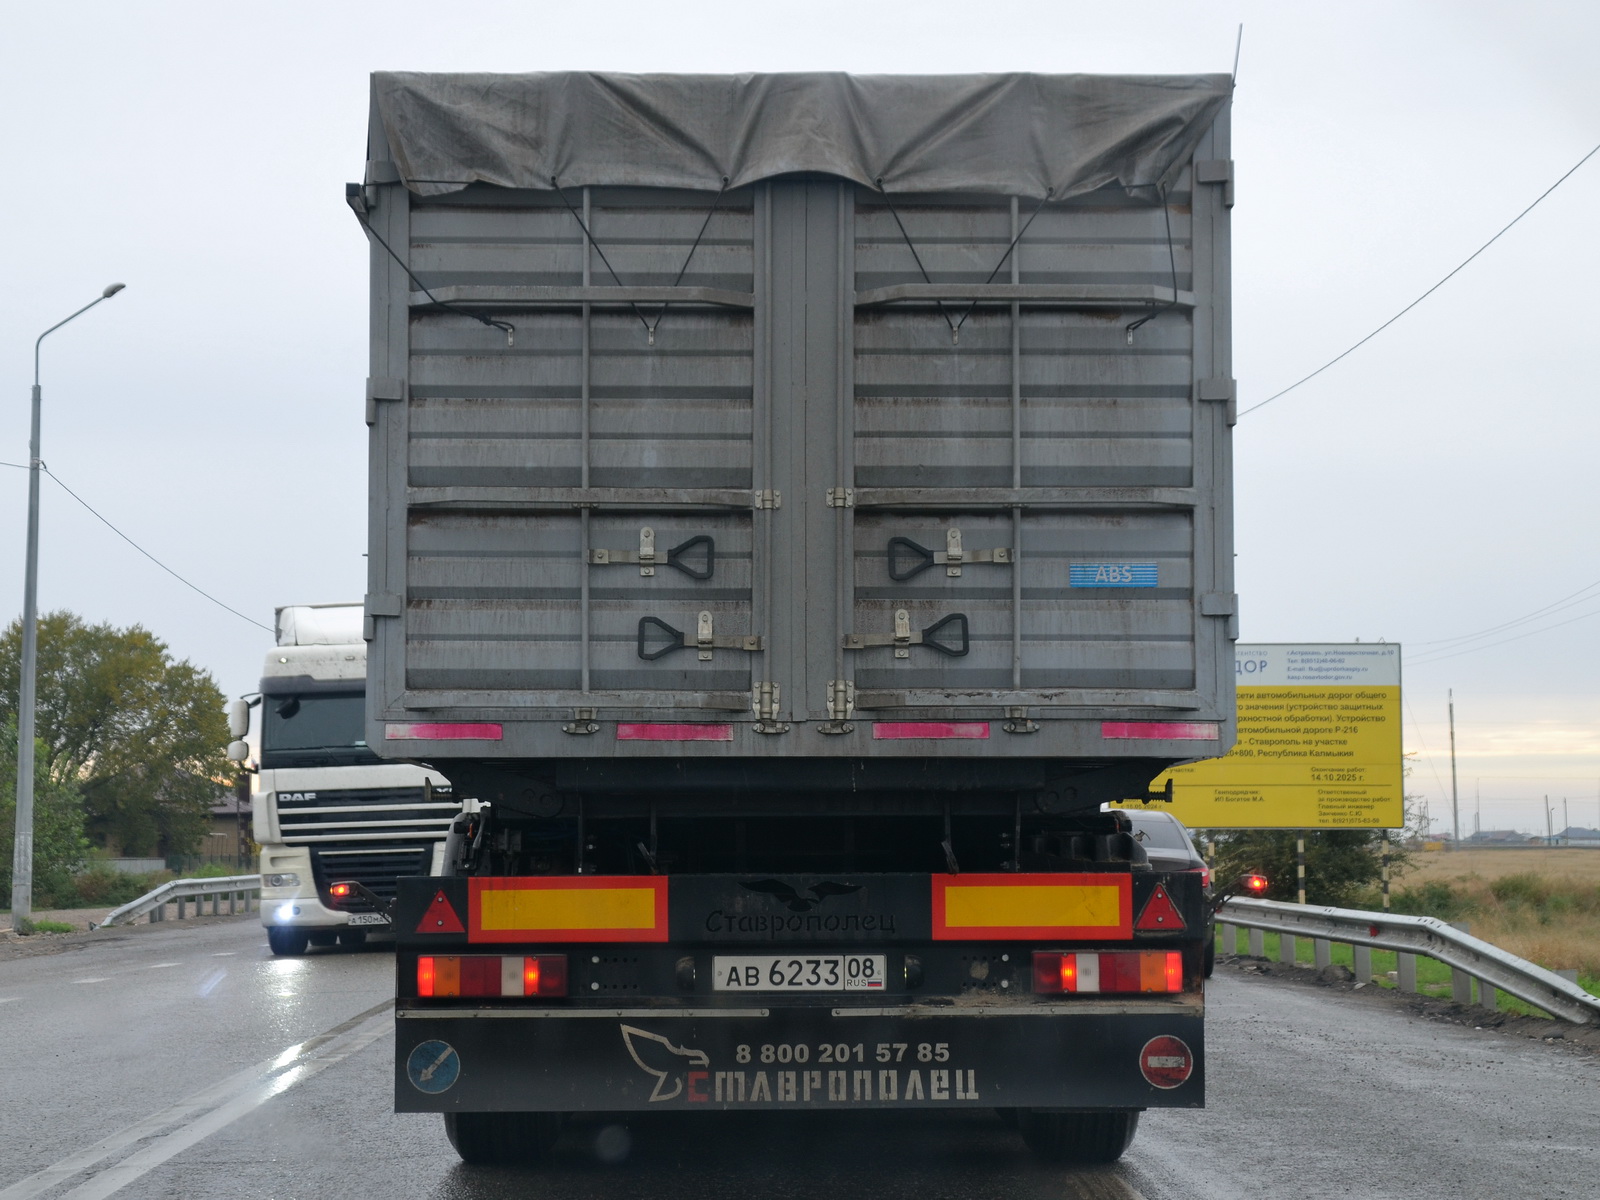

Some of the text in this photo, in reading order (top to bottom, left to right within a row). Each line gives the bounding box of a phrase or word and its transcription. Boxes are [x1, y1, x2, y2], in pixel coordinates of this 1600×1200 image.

[1095, 566, 1133, 583] ABS
[1257, 691, 1325, 699] автомобильных
[1328, 693, 1352, 701] дорог
[1355, 691, 1387, 700] общего
[1286, 703, 1338, 712] (устройство
[1337, 715, 1386, 723] Устройство
[1249, 738, 1301, 747] Ставрополь
[1315, 739, 1348, 747] участке
[1258, 749, 1307, 759] Республика
[1310, 749, 1354, 757] Калмыкия
[279, 792, 317, 802] DAF
[705, 910, 895, 939] Ставрополец
[726, 958, 875, 987] АВ 6233 08
[736, 1043, 950, 1064] 8 800 201 57 85
